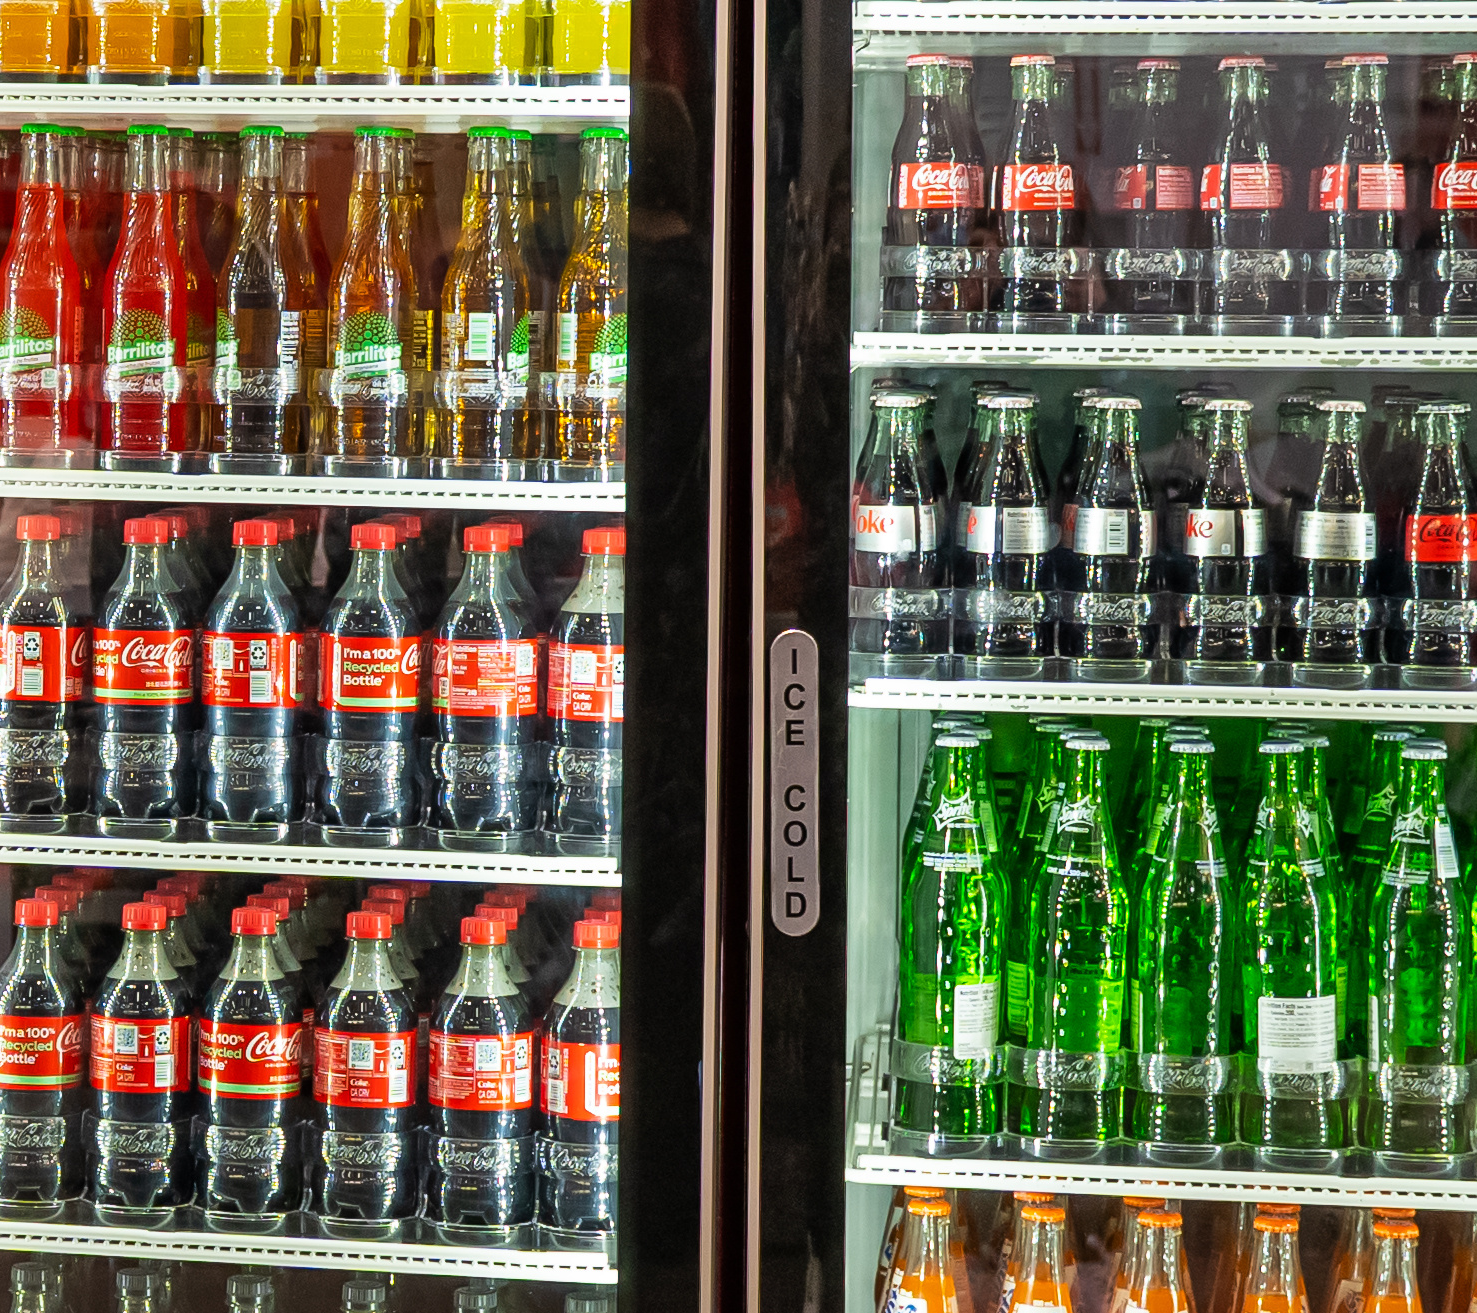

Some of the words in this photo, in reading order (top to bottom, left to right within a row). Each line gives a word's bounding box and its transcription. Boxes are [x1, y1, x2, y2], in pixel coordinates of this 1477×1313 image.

[107, 339, 174, 361] Barrilitos
[334, 343, 402, 365] Barrilitos
[342, 661, 399, 674] Recycled
[783, 648, 807, 747] ICE
[782, 784, 807, 919] COLD
